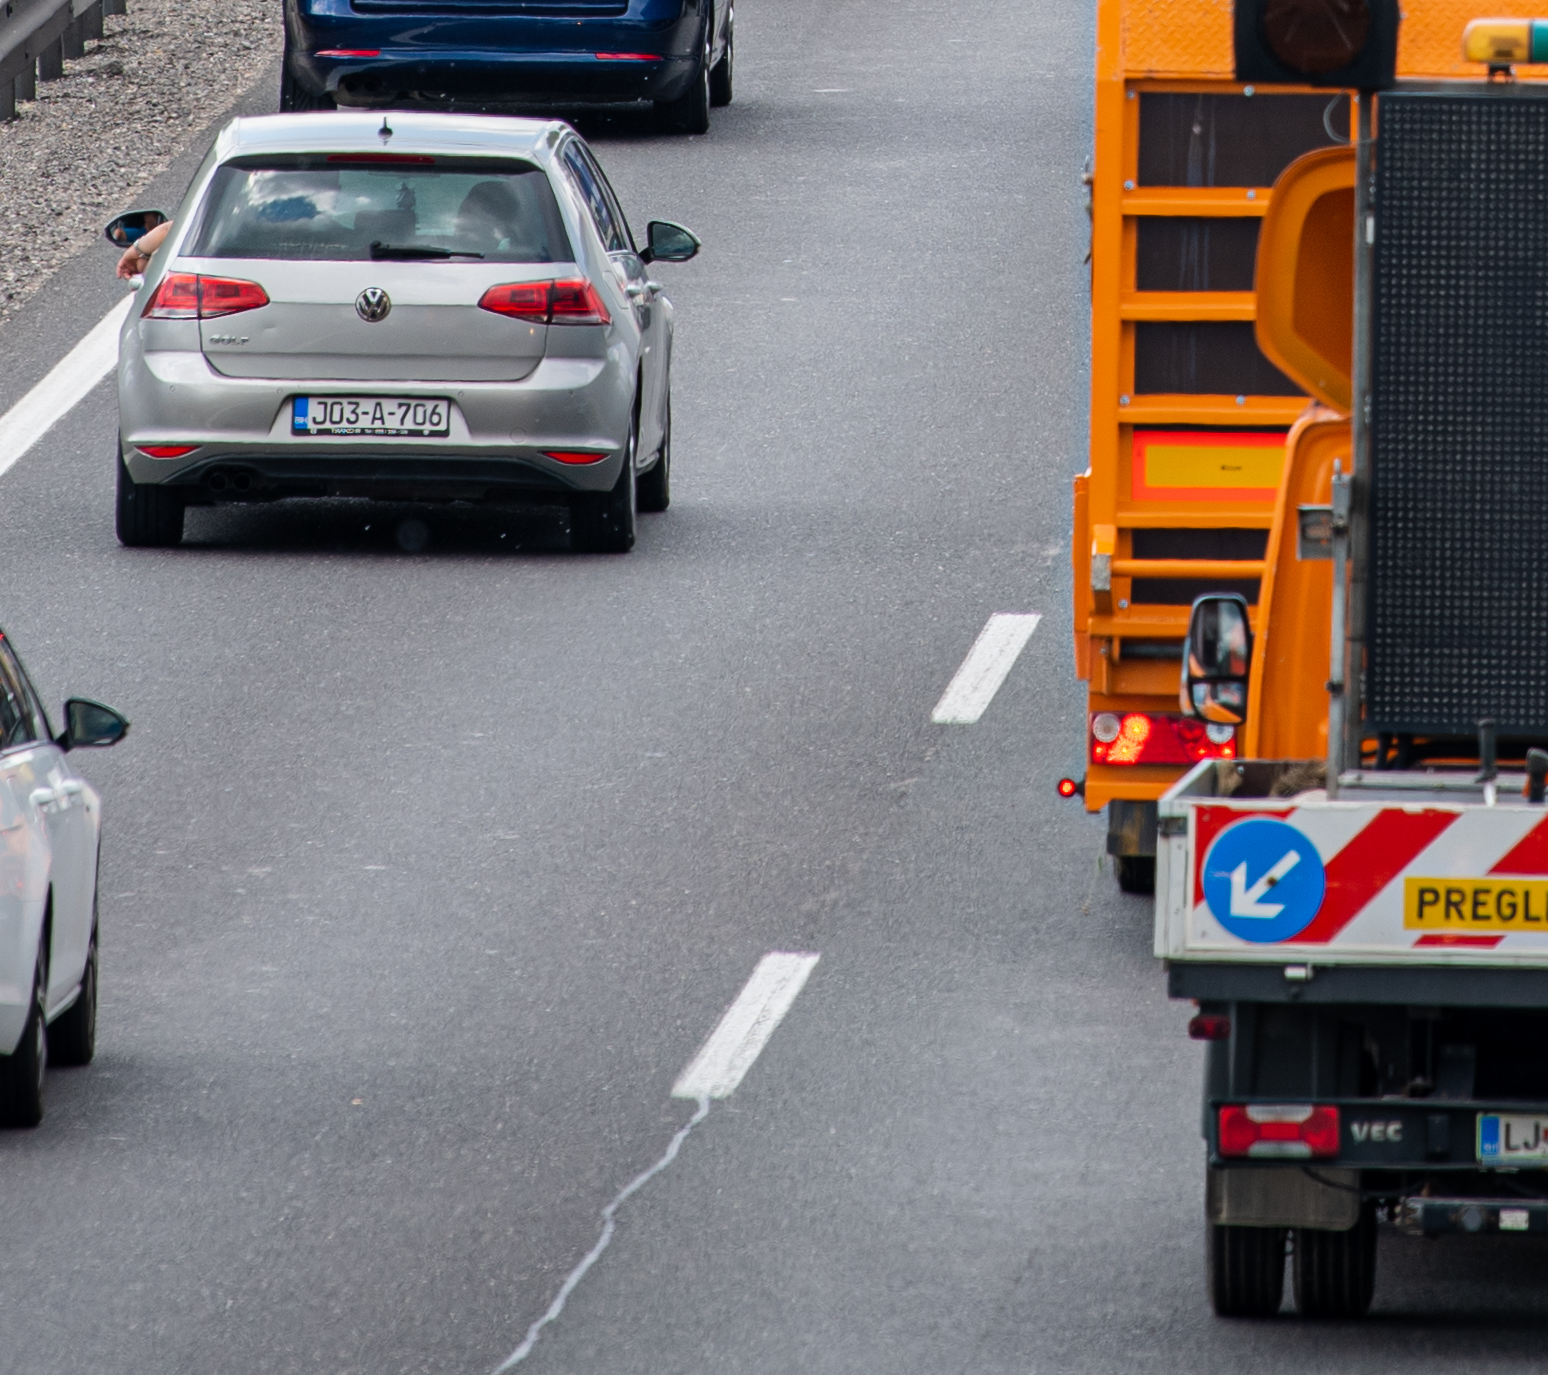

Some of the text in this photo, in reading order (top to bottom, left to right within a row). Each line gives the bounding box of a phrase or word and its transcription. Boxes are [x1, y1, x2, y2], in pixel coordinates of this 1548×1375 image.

[209, 334, 250, 345] GOLF
[312, 401, 442, 427] J03-A-706
[1504, 1121, 1541, 1152] LJ
